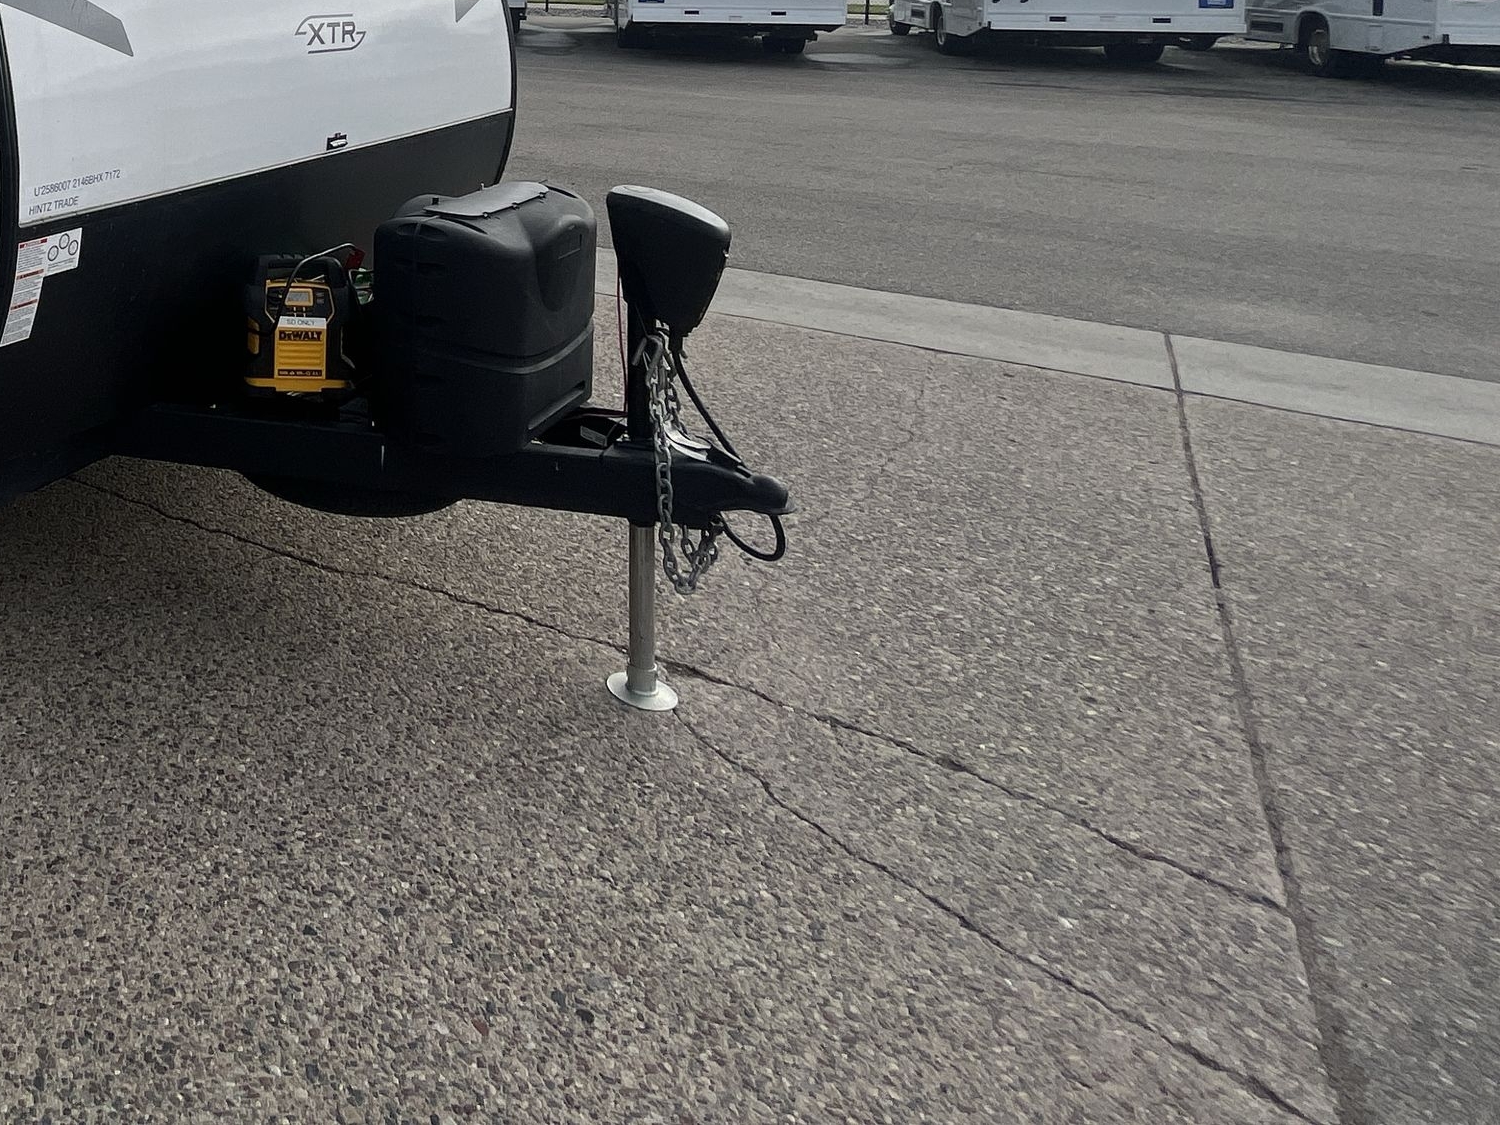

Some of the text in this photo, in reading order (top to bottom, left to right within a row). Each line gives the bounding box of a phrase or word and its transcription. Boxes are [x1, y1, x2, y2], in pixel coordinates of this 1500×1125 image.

[306, 21, 356, 46] XTR
[28, 195, 80, 216] HINTZ TRADE
